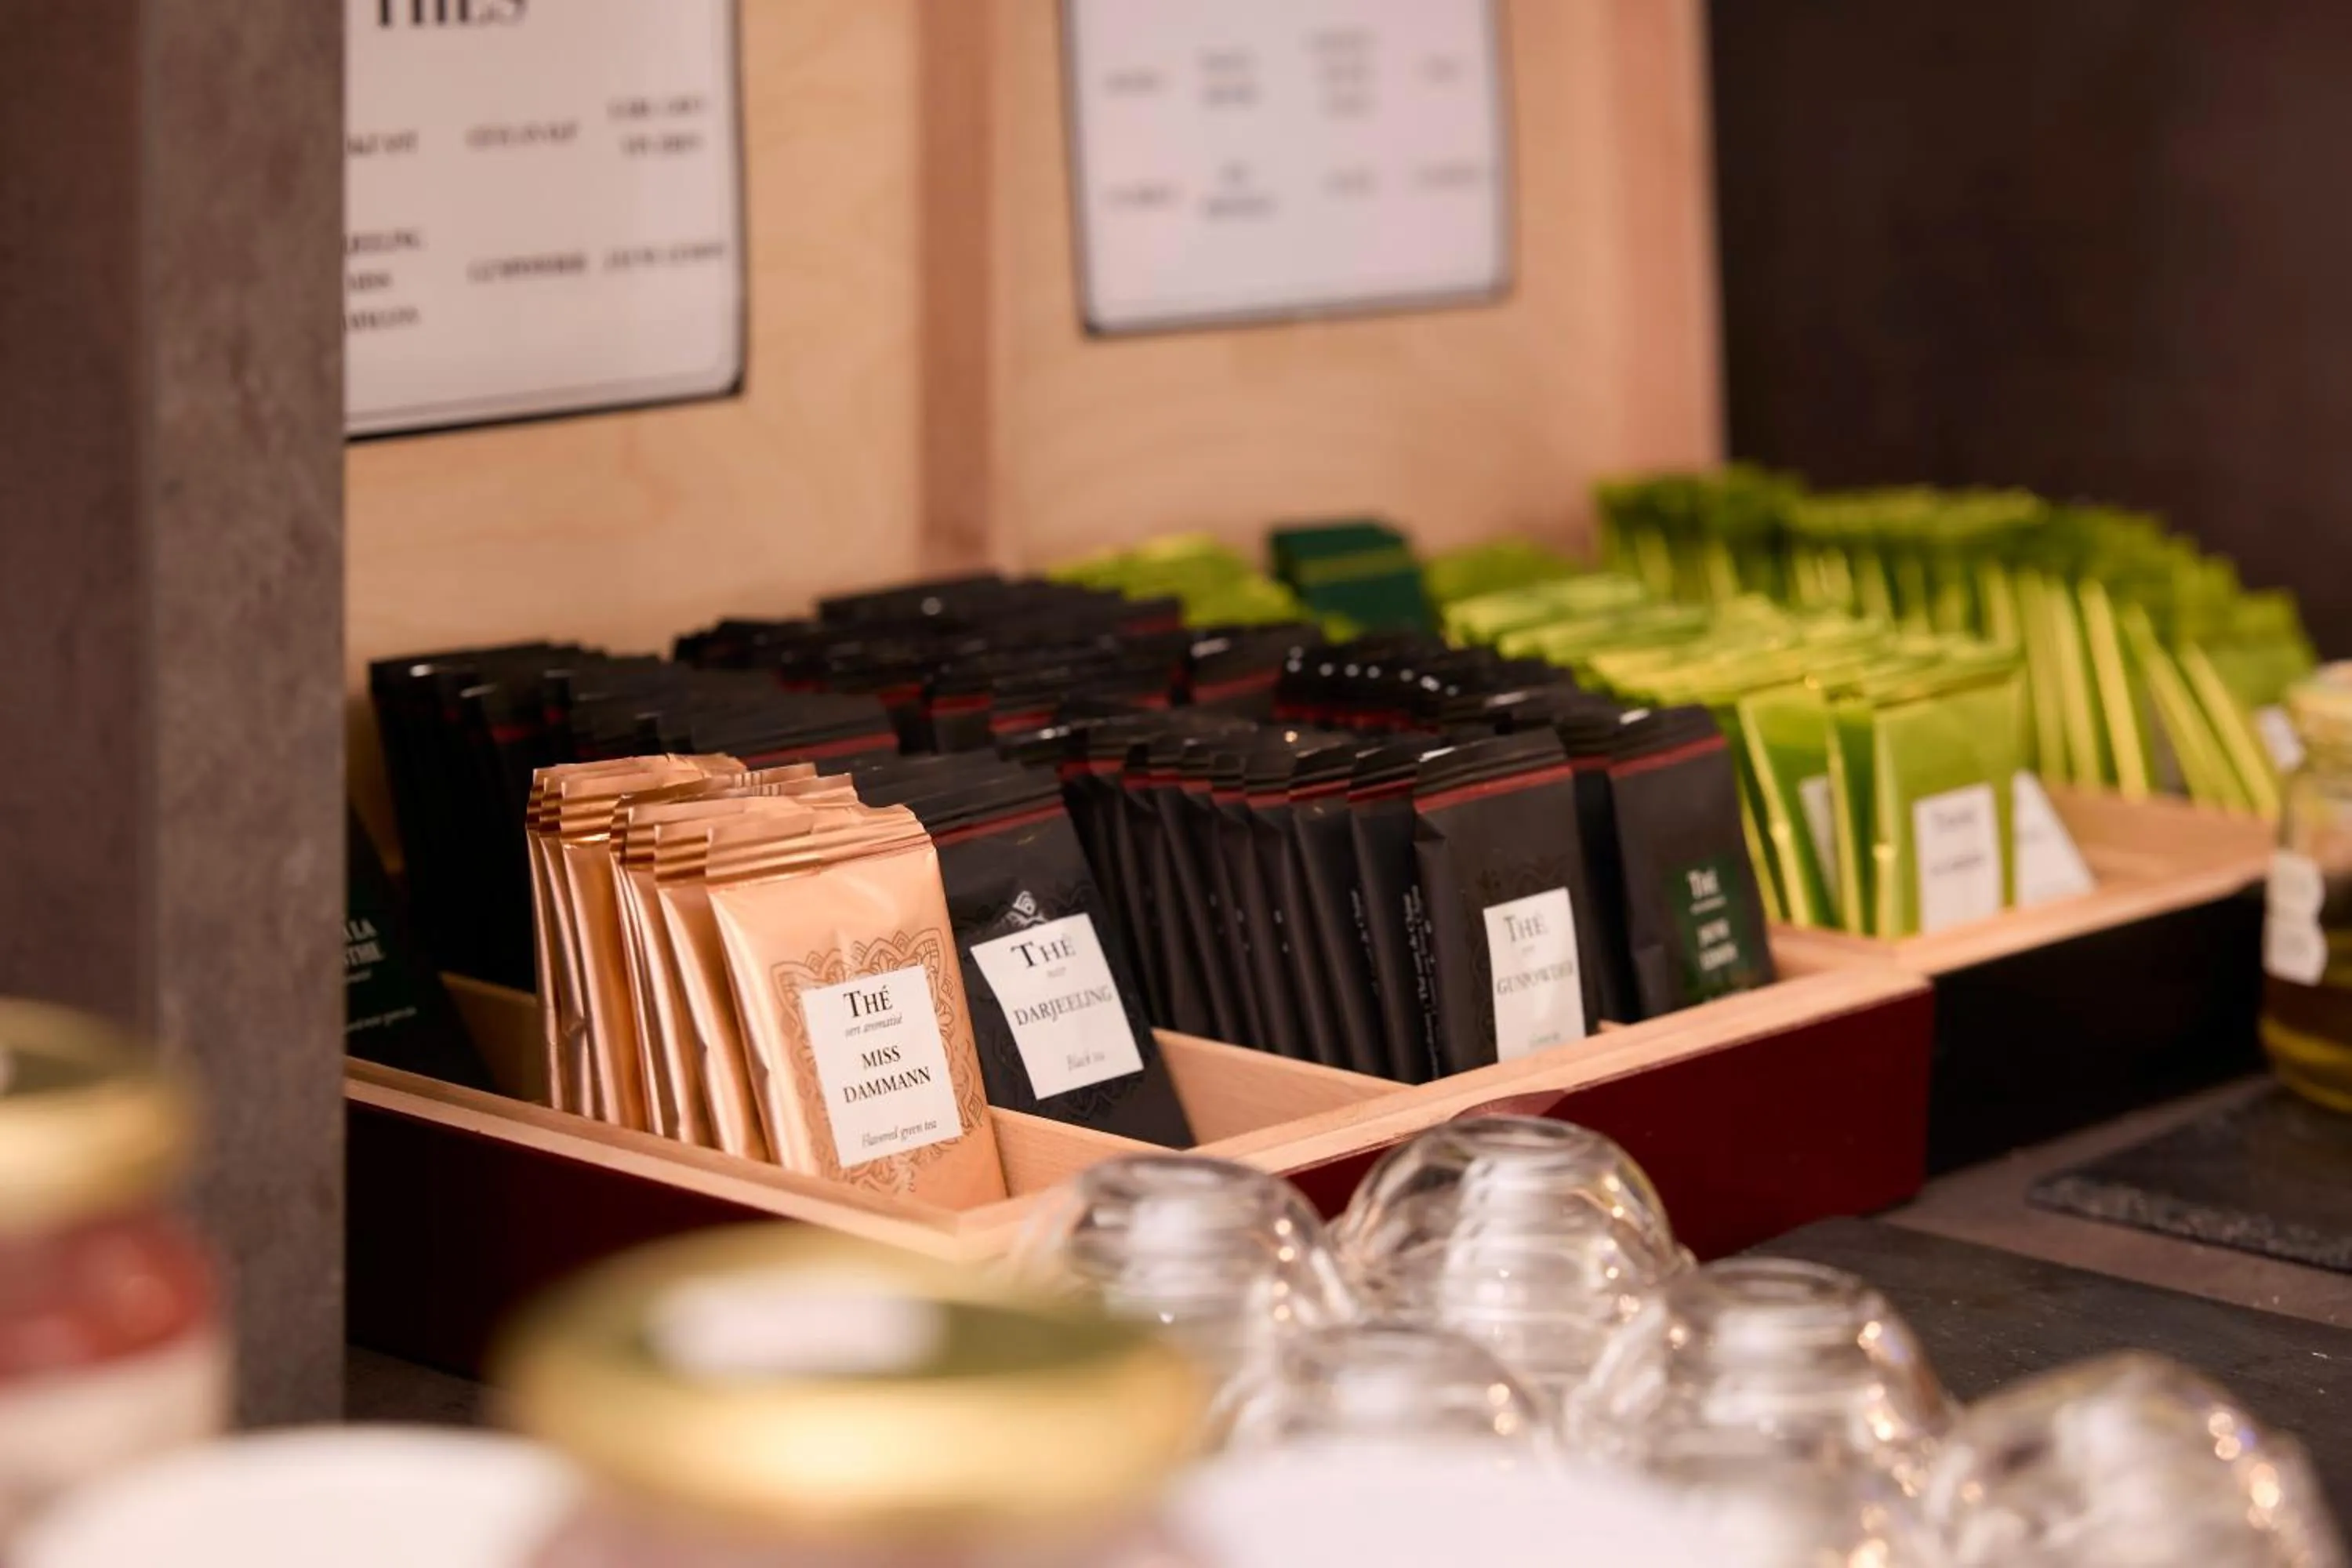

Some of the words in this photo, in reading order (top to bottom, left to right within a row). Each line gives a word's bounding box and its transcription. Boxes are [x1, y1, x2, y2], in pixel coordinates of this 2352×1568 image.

[1010, 934, 1076, 968] THÉ
[843, 985, 892, 1018] THÉ
[1014, 985, 1112, 1025] DARJEELING
[862, 1045, 901, 1069] MISS
[843, 1066, 931, 1103] DAMMANN
[901, 1124, 923, 1142] green
[924, 1120, 937, 1131] tea
